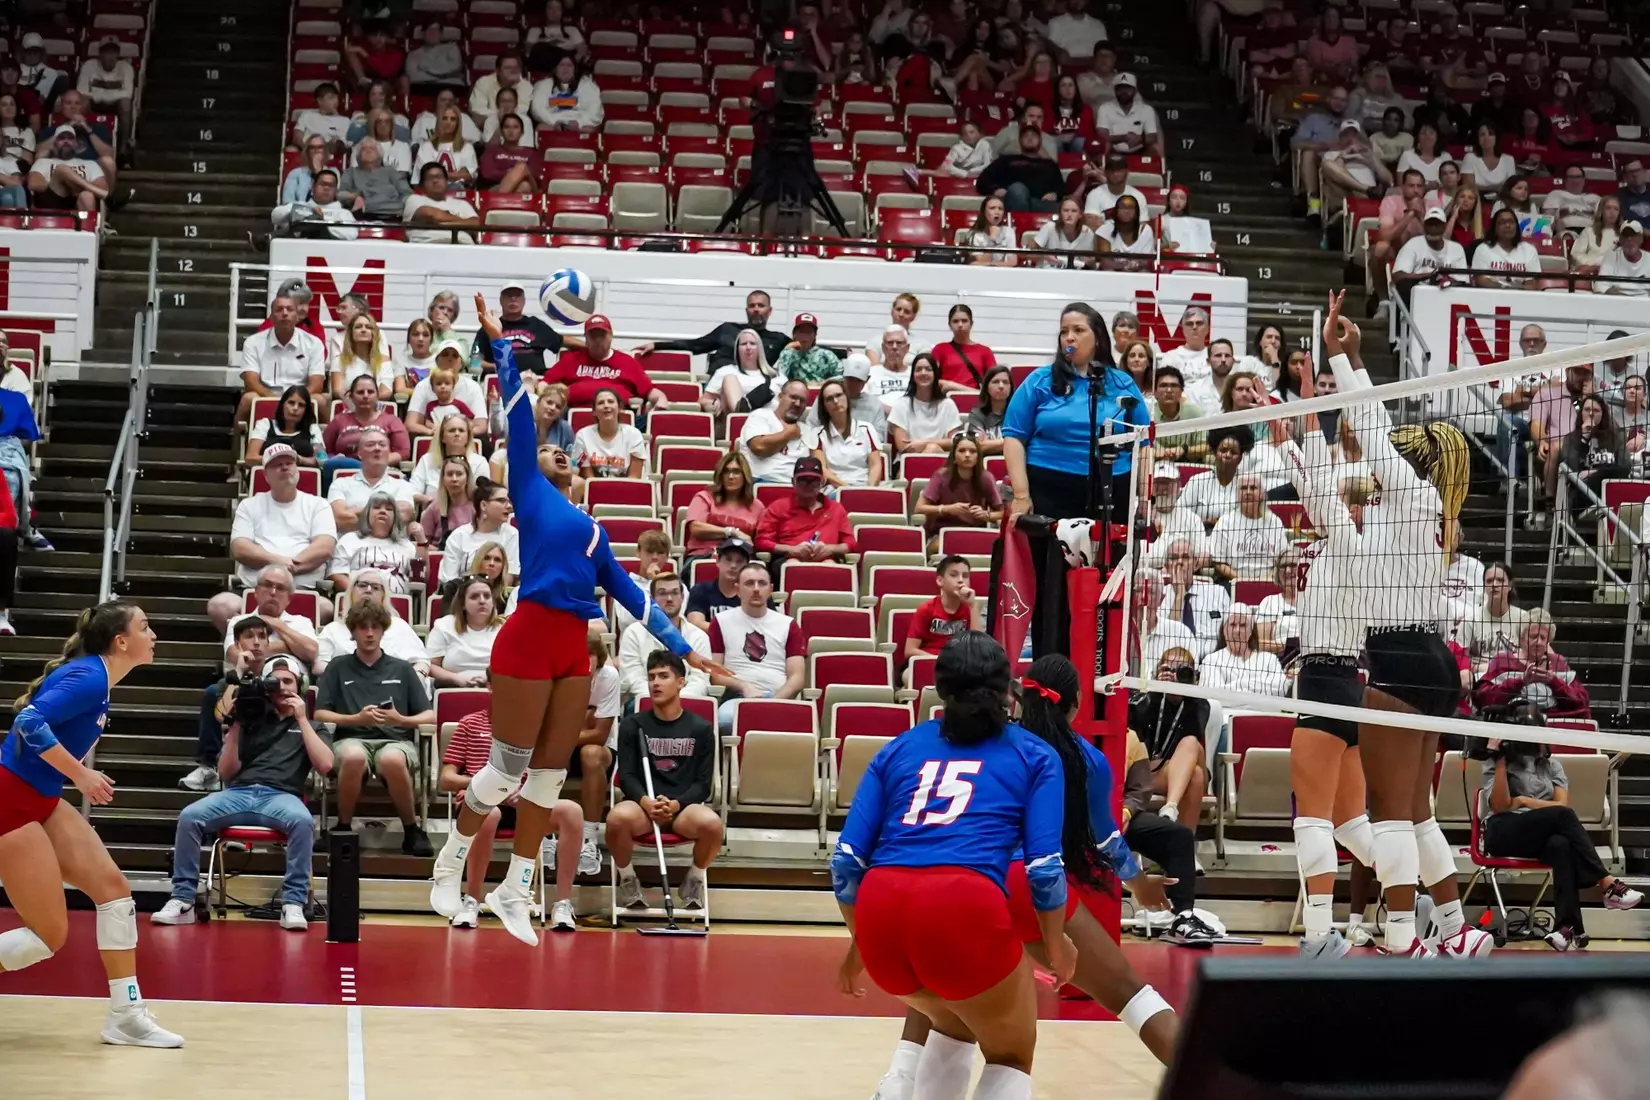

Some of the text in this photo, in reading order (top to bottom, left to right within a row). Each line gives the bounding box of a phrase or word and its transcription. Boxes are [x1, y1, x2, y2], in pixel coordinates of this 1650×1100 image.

[218, 43, 231, 53] 19
[206, 69, 219, 80] 18
[1152, 82, 1166, 93] 19
[201, 98, 215, 109] 17
[1166, 109, 1179, 121] 18
[199, 129, 213, 141] 16
[1181, 139, 1195, 150] 17
[192, 162, 207, 173] 15
[1199, 171, 1213, 182] 16
[187, 192, 202, 204] 14
[1216, 202, 1231, 214] 15
[183, 225, 198, 238] 13
[1236, 233, 1251, 246] 14
[178, 260, 193, 272] 12
[1257, 267, 1272, 279] 13
[306, 256, 385, 331] M
[173, 294, 185, 306] 11
[1135, 290, 1212, 352] M
[1299, 336, 1312, 349] 11
[1450, 304, 1511, 388] N
[576, 364, 622, 379] ARKANSAS
[1297, 562, 1311, 592] 8
[1305, 656, 1338, 665] PRO
[901, 759, 984, 826] 15
